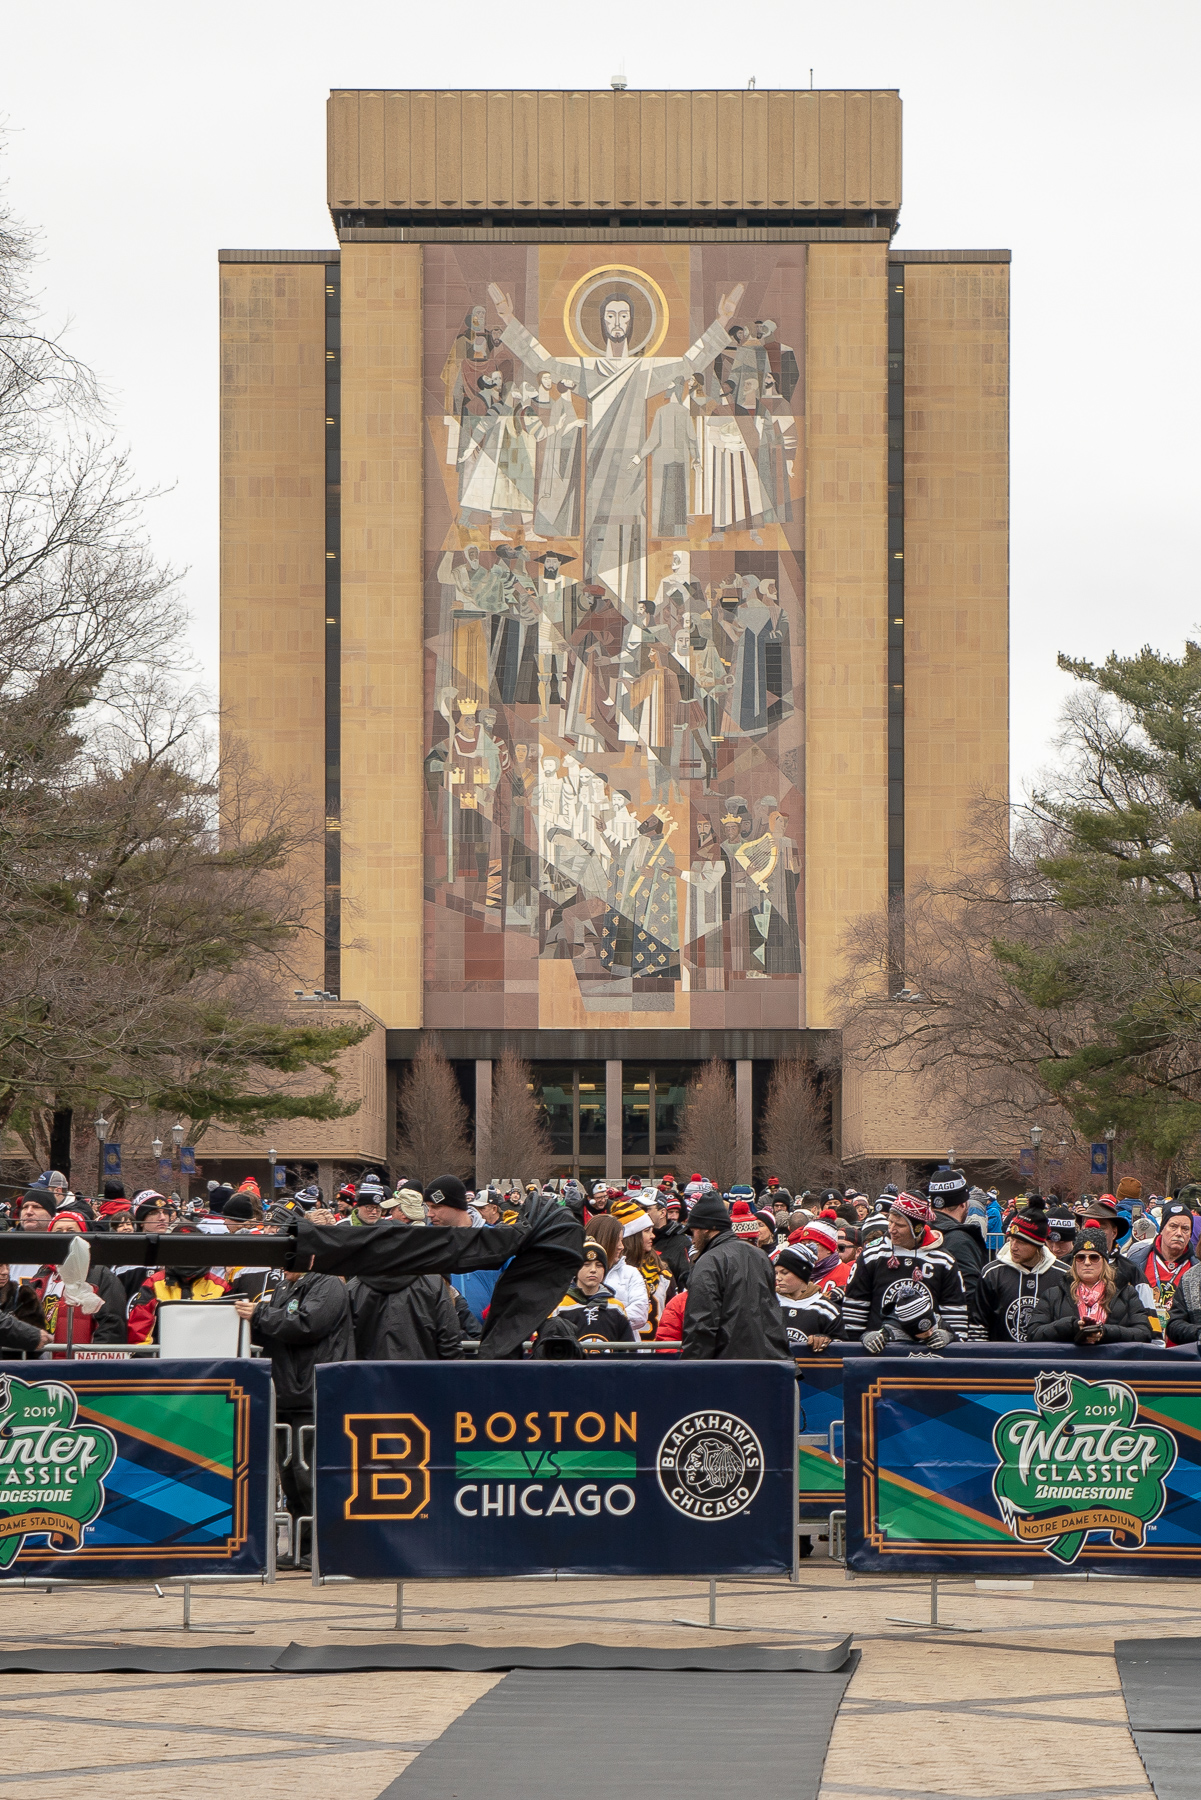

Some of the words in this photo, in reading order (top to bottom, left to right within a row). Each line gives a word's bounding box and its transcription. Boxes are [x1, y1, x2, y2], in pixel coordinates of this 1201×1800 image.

[1042, 1384, 1066, 1404] NHL
[24, 1406, 56, 1418] 2019
[1085, 1405, 1117, 1416] 2019
[455, 1411, 637, 1443] BOSTON
[0, 1412, 100, 1476] inter
[661, 1415, 760, 1468] BLACKHAWKS
[1009, 1410, 1160, 1485] Winter
[343, 1413, 430, 1520] B
[520, 1450, 562, 1479] VS
[1034, 1463, 1140, 1483] CLASSIC
[0, 1465, 79, 1486] ASSIC
[0, 1489, 73, 1503] DGESTONE
[454, 1484, 637, 1517] CHICAGO
[671, 1487, 750, 1516] CHICAGO
[1034, 1484, 1135, 1500] BRIDGESTONE
[30, 1516, 74, 1532] STADIUM
[1023, 1521, 1059, 1534] NOTRE
[1061, 1516, 1090, 1528] DAME
[1092, 1513, 1136, 1530] STADIUM
